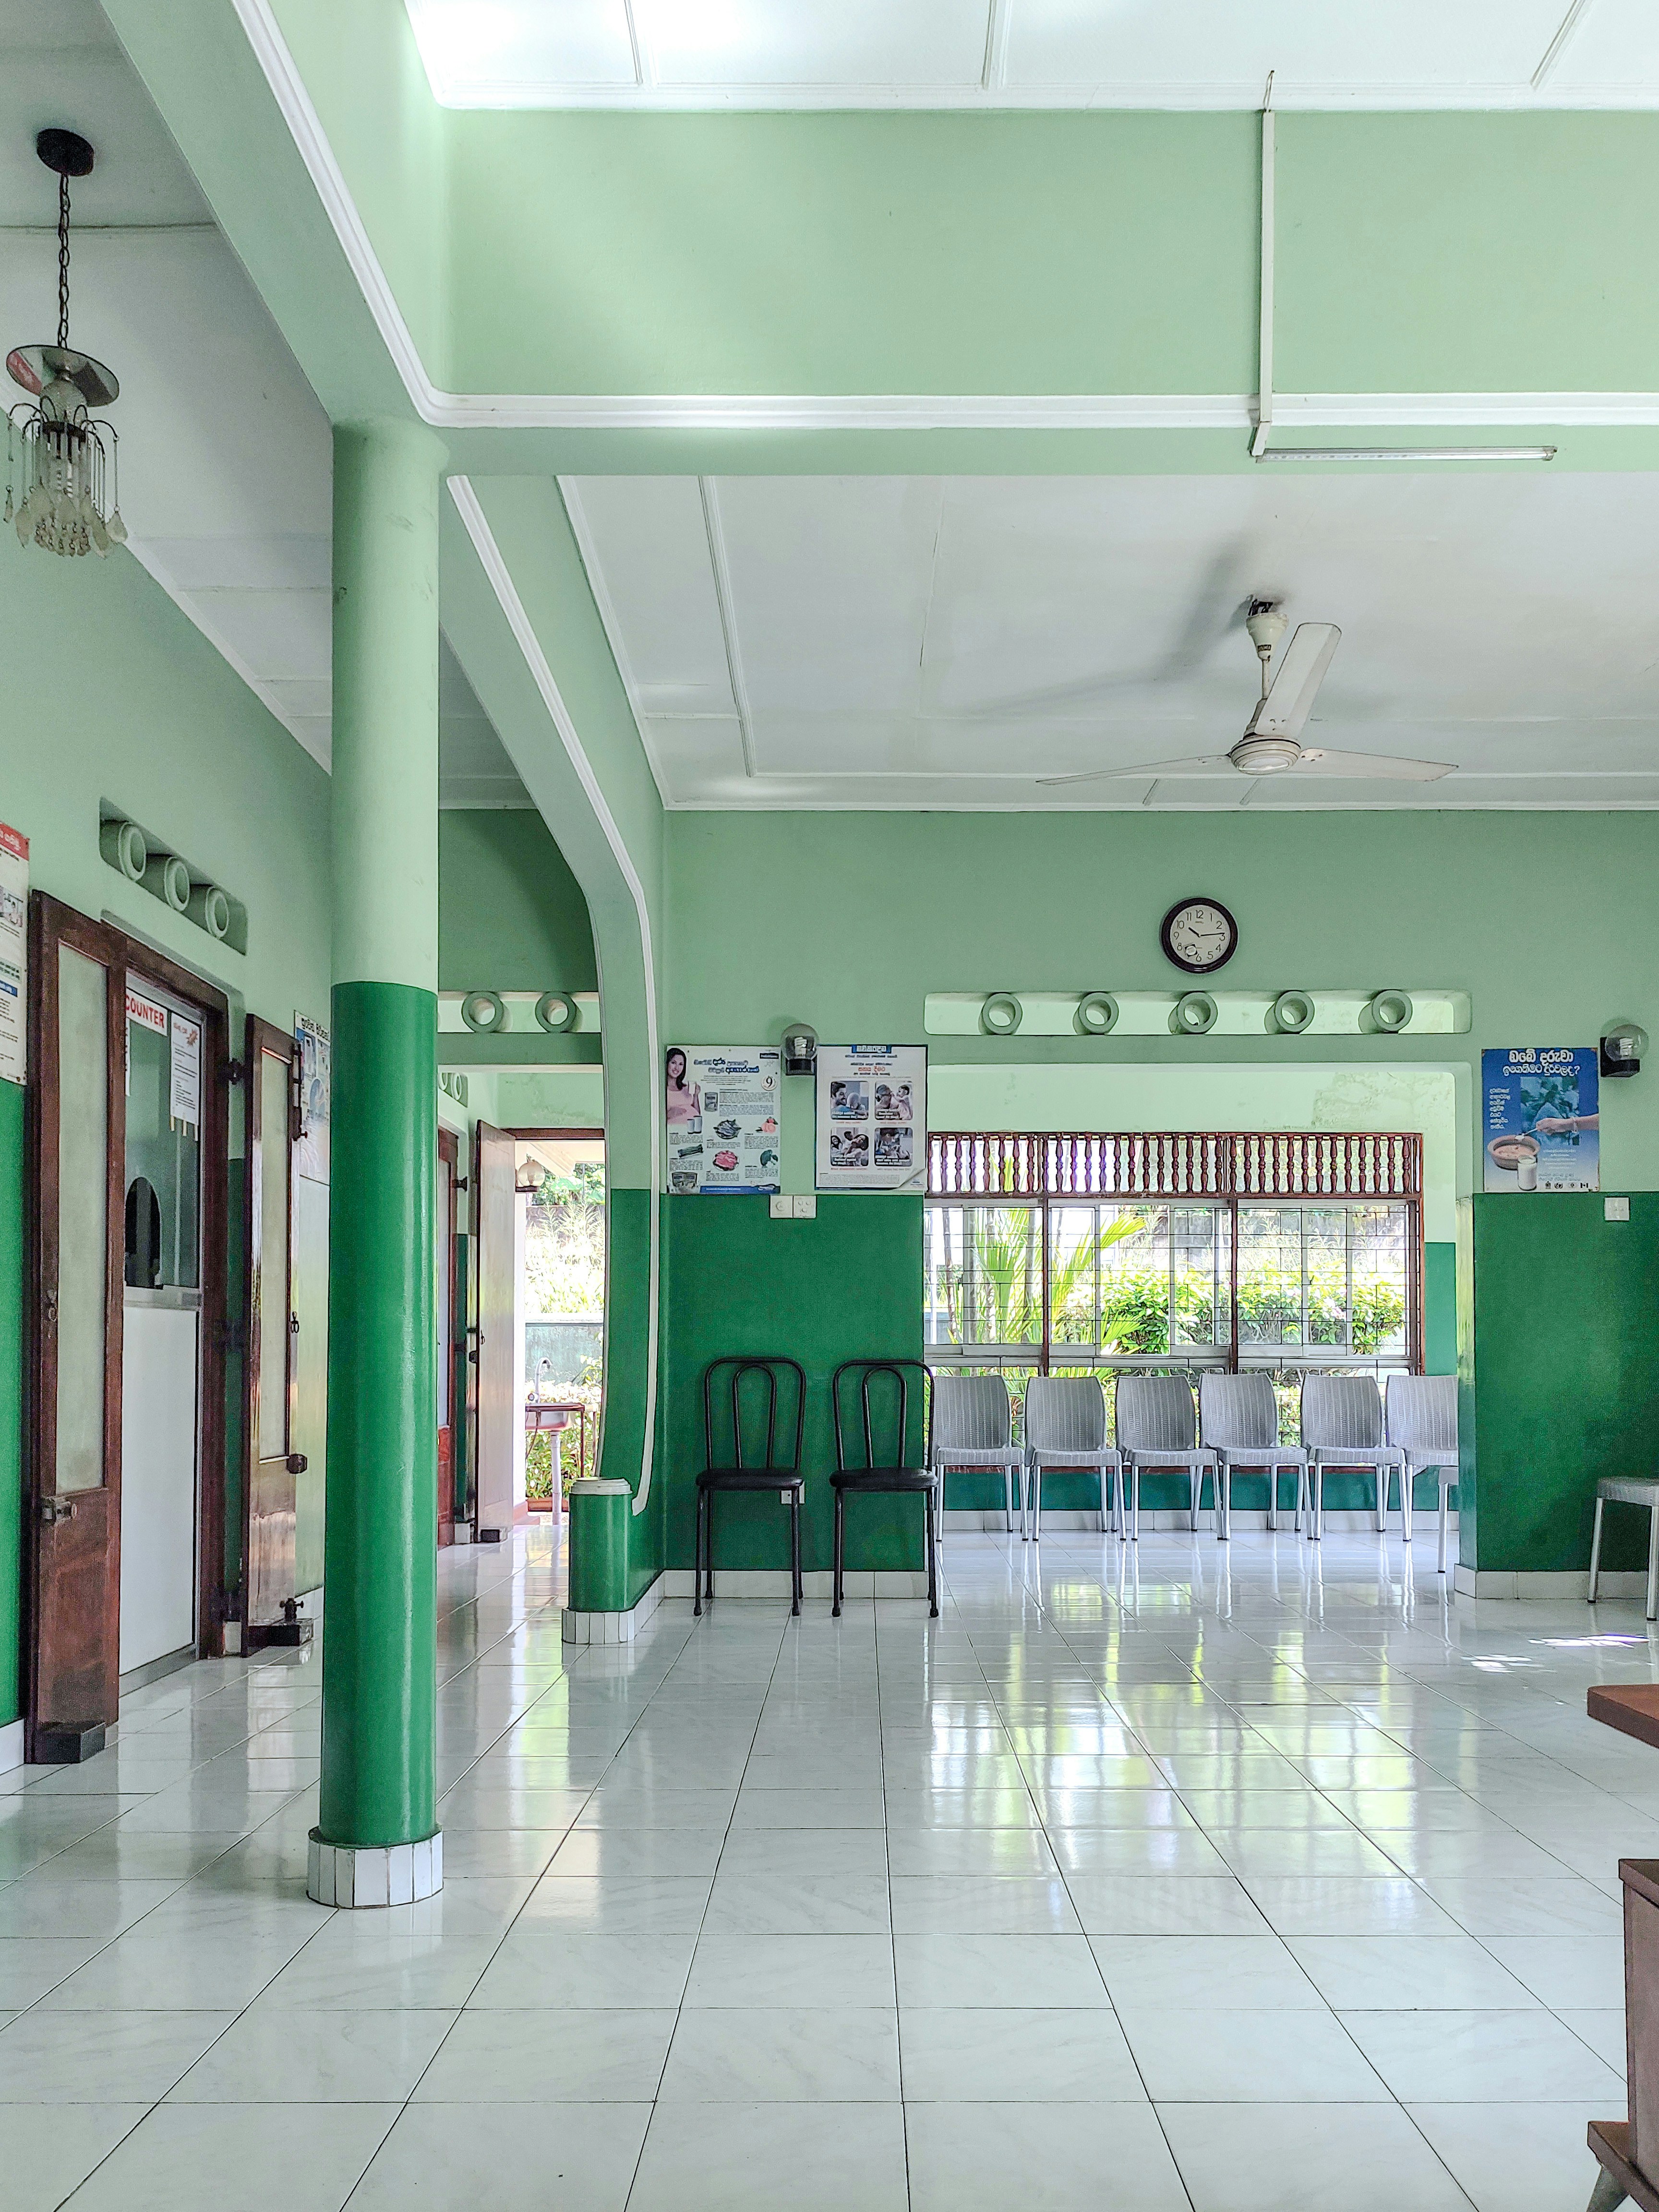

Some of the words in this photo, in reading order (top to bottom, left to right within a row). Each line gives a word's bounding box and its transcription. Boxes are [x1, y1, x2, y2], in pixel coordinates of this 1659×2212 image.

[1186, 913, 1191, 921] 11
[1196, 910, 1203, 919] 12
[1210, 913, 1213, 922] 1
[1177, 920, 1184, 929] 10
[1216, 921, 1222, 929] 2
[1173, 931, 1179, 940] 9
[1219, 933, 1226, 941] 3
[1177, 942, 1182, 951] 8
[1215, 944, 1222, 952] 4
[1196, 953, 1202, 962] 6
[1207, 951, 1214, 960] 5
[125, 995, 164, 1028] COUNTER
[1509, 1048, 1536, 1062] ඔබේ
[1539, 1049, 1574, 1066] දරුවා
[766, 1077, 772, 1087] 9
